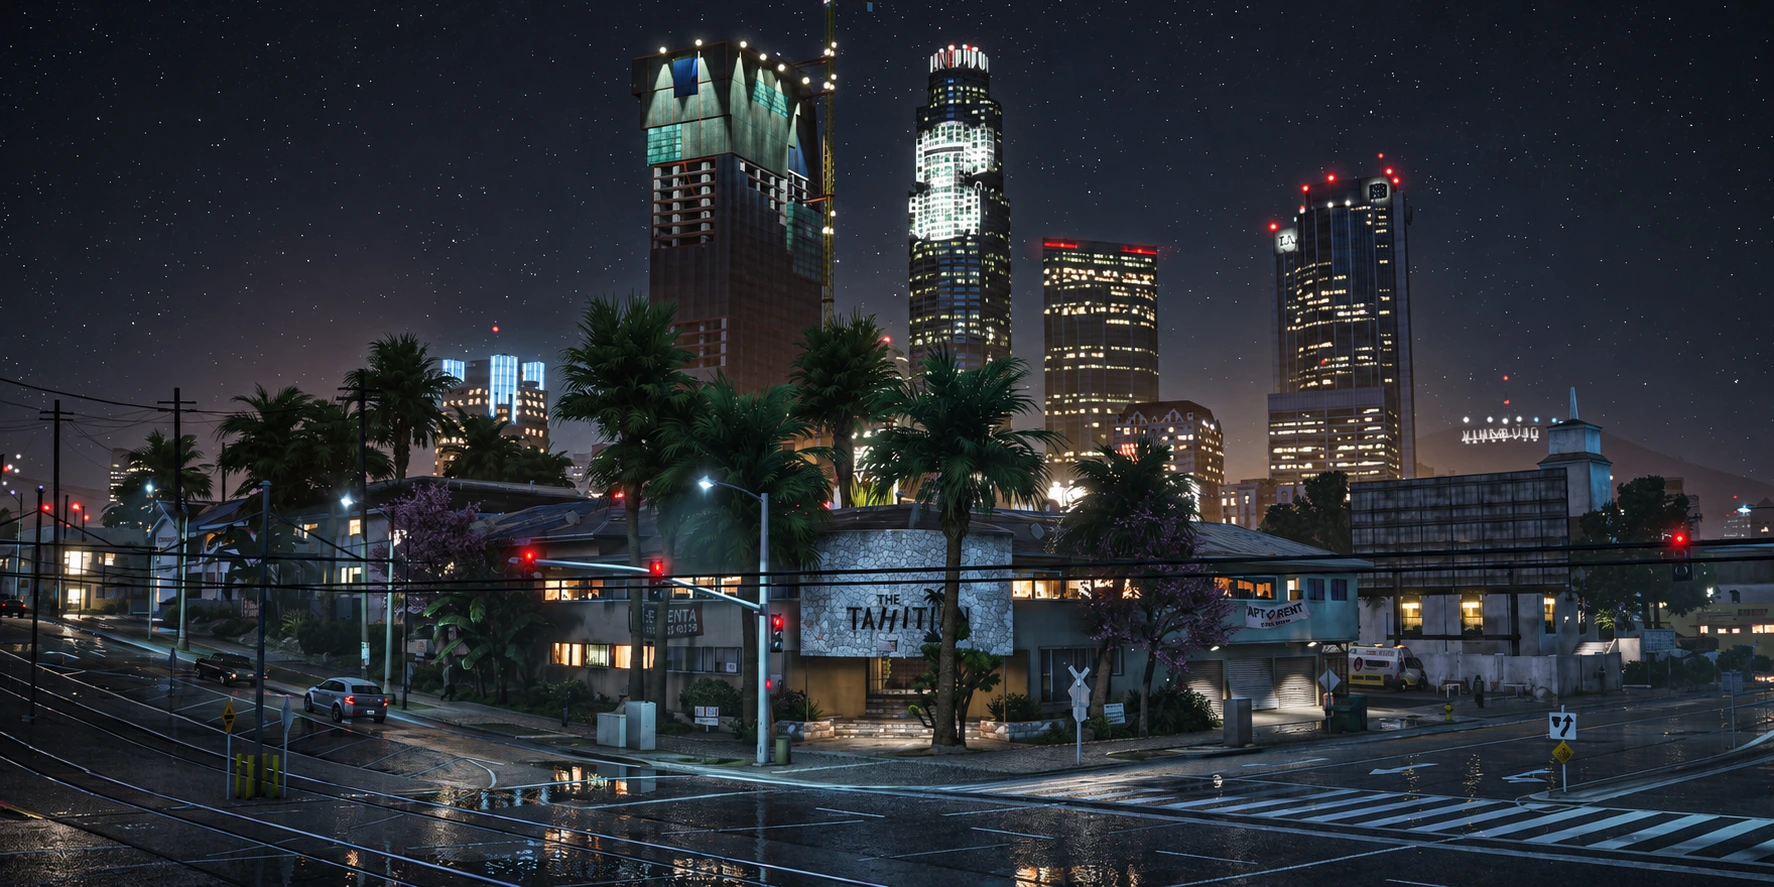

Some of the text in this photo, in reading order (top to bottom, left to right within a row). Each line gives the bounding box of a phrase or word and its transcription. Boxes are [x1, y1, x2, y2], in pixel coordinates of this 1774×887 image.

[877, 594, 900, 605] THE
[664, 609, 697, 623] ENTA
[1277, 603, 1302, 618] RENT
[847, 606, 970, 633] TAHITIN
